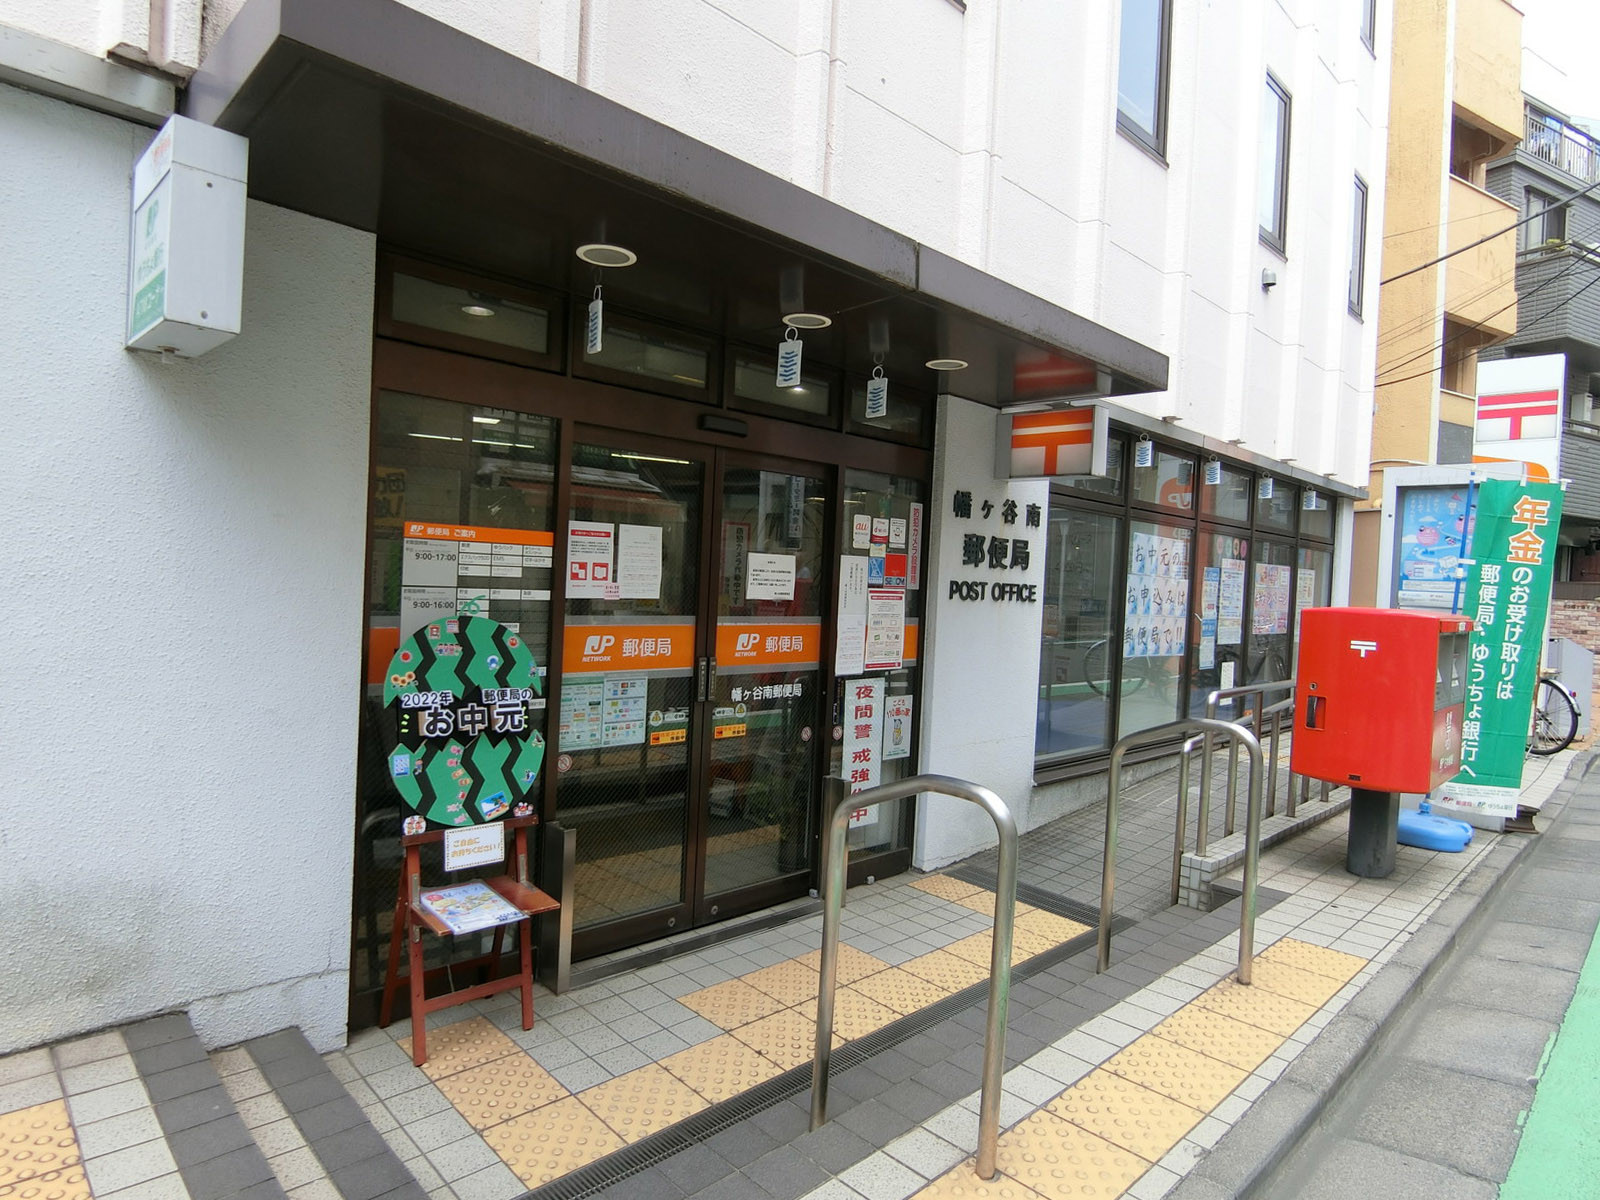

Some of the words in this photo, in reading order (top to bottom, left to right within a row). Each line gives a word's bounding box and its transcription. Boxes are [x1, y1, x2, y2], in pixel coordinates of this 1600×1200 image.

[952, 490, 1042, 528] 幡ヶ谷南
[427, 527, 449, 537] 郵便局
[454, 529, 476, 539] ご案内
[855, 523, 869, 531] au
[415, 552, 457, 561] 9:00-17:00
[962, 533, 1031, 571] 郵便局
[1134, 543, 1182, 567] お中元の
[884, 577, 905, 587] SECOM
[949, 580, 988, 601] POST
[991, 582, 1038, 602] OFFICE
[412, 601, 455, 609] 9:00-16:00
[1127, 584, 1186, 607] お申込みは
[1496, 494, 1551, 700] 年金のお受け取りは
[584, 635, 615, 655] JP
[622, 638, 672, 657] 郵便局
[736, 633, 761, 651] JP
[765, 636, 803, 653] 郵便局
[402, 692, 453, 707] 2022年
[483, 688, 533, 703] 郵便局の
[731, 683, 802, 702] 幡ヶ谷南郵便局
[424, 704, 524, 736] お中元
[849, 685, 875, 823] 夜間警戒強中
